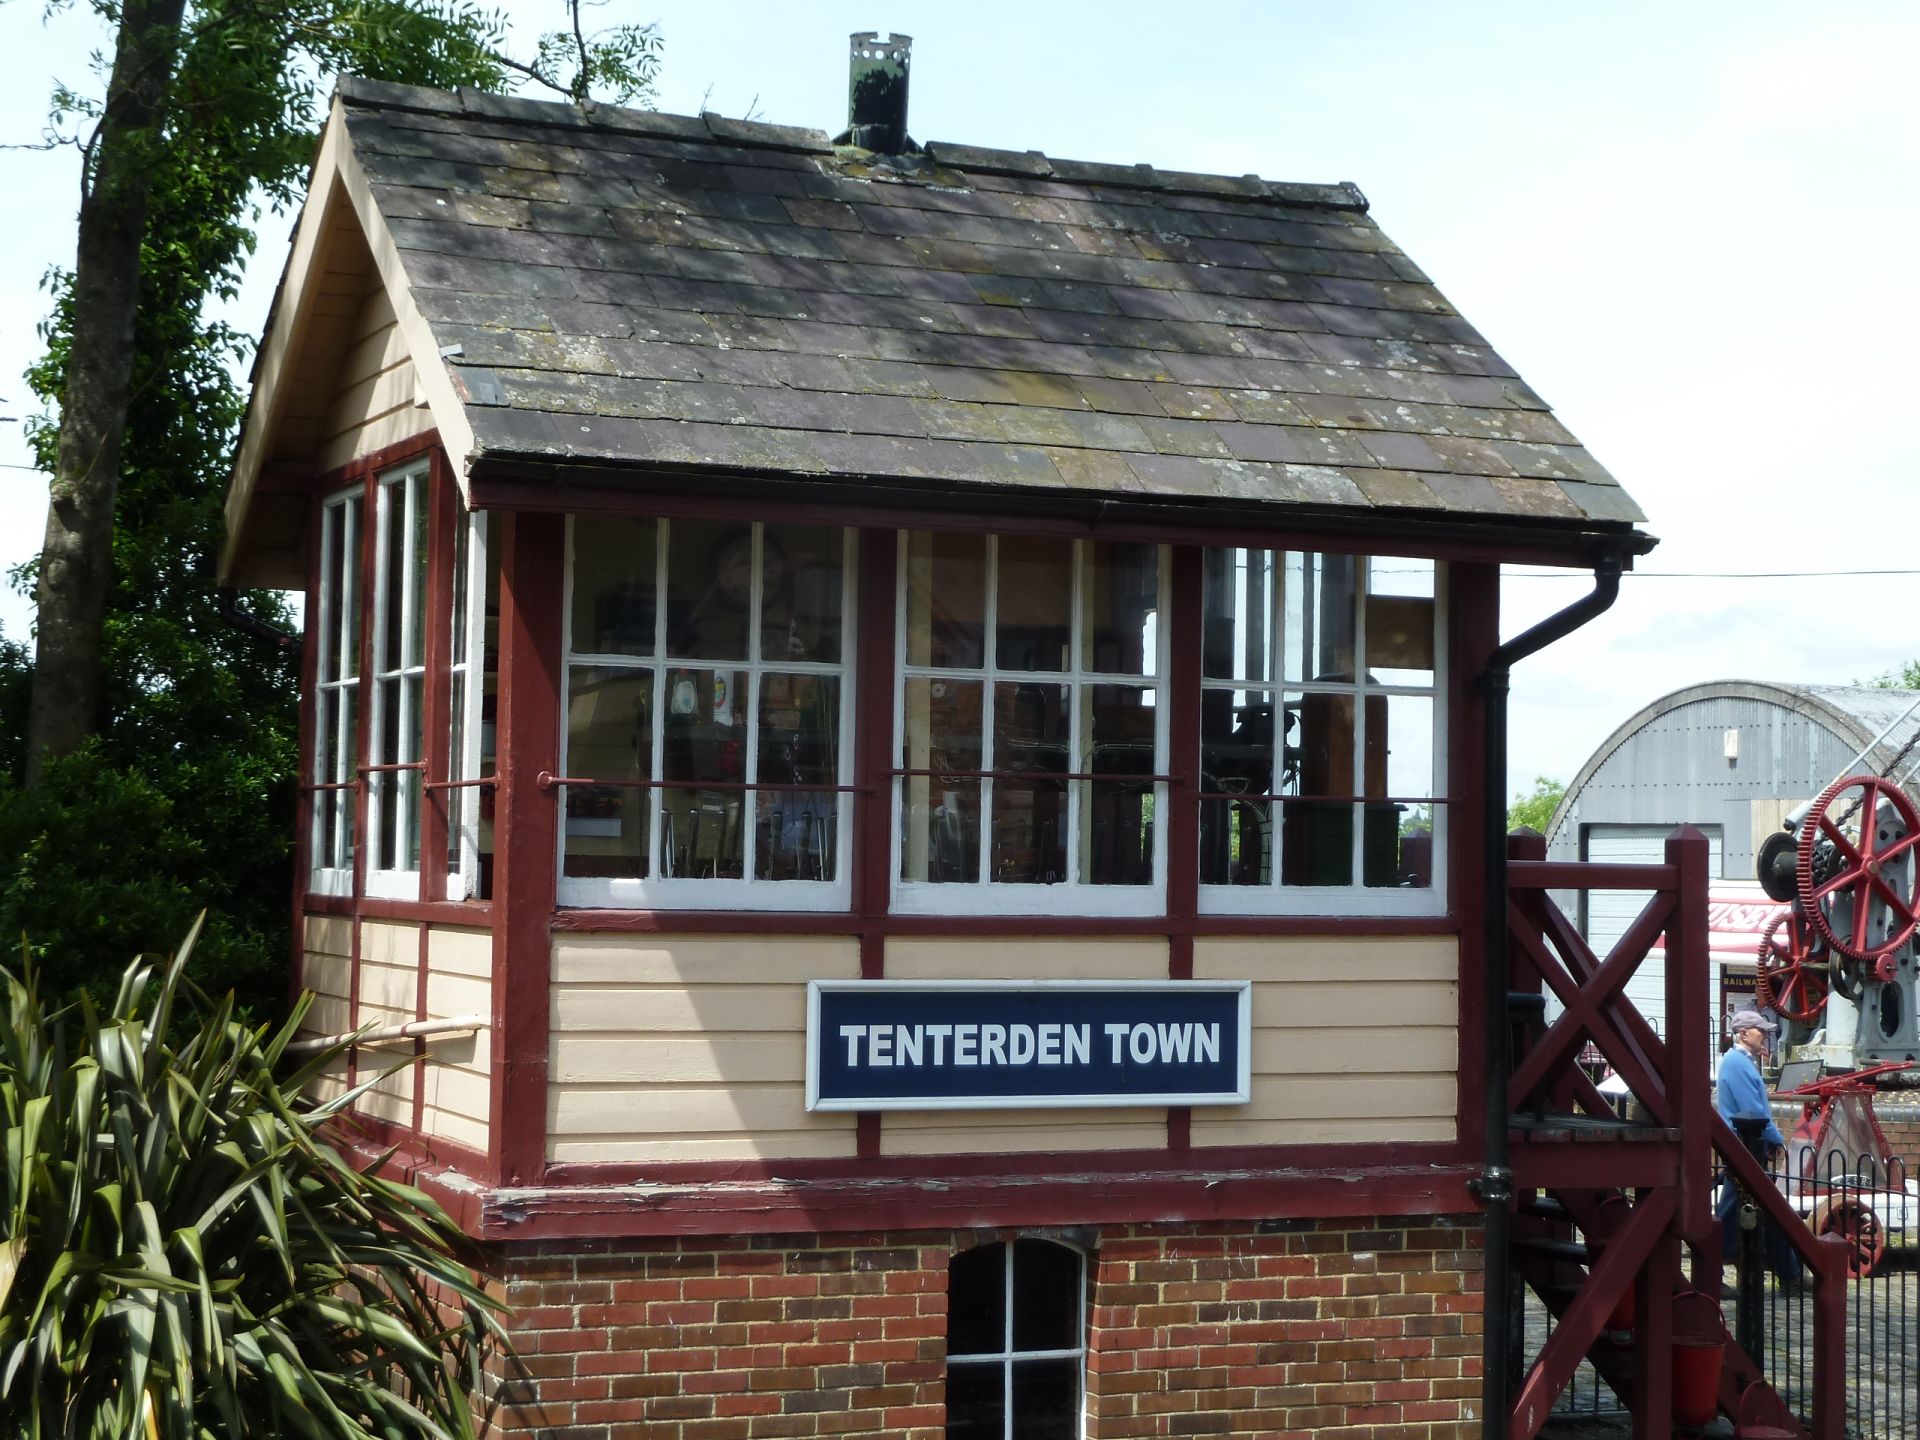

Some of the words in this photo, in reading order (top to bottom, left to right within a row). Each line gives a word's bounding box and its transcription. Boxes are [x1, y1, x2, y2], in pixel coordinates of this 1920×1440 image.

[1723, 977, 1759, 986] RAILWA
[839, 1024, 1091, 1067] TENTERDEN
[1104, 1022, 1220, 1064] TOWN
